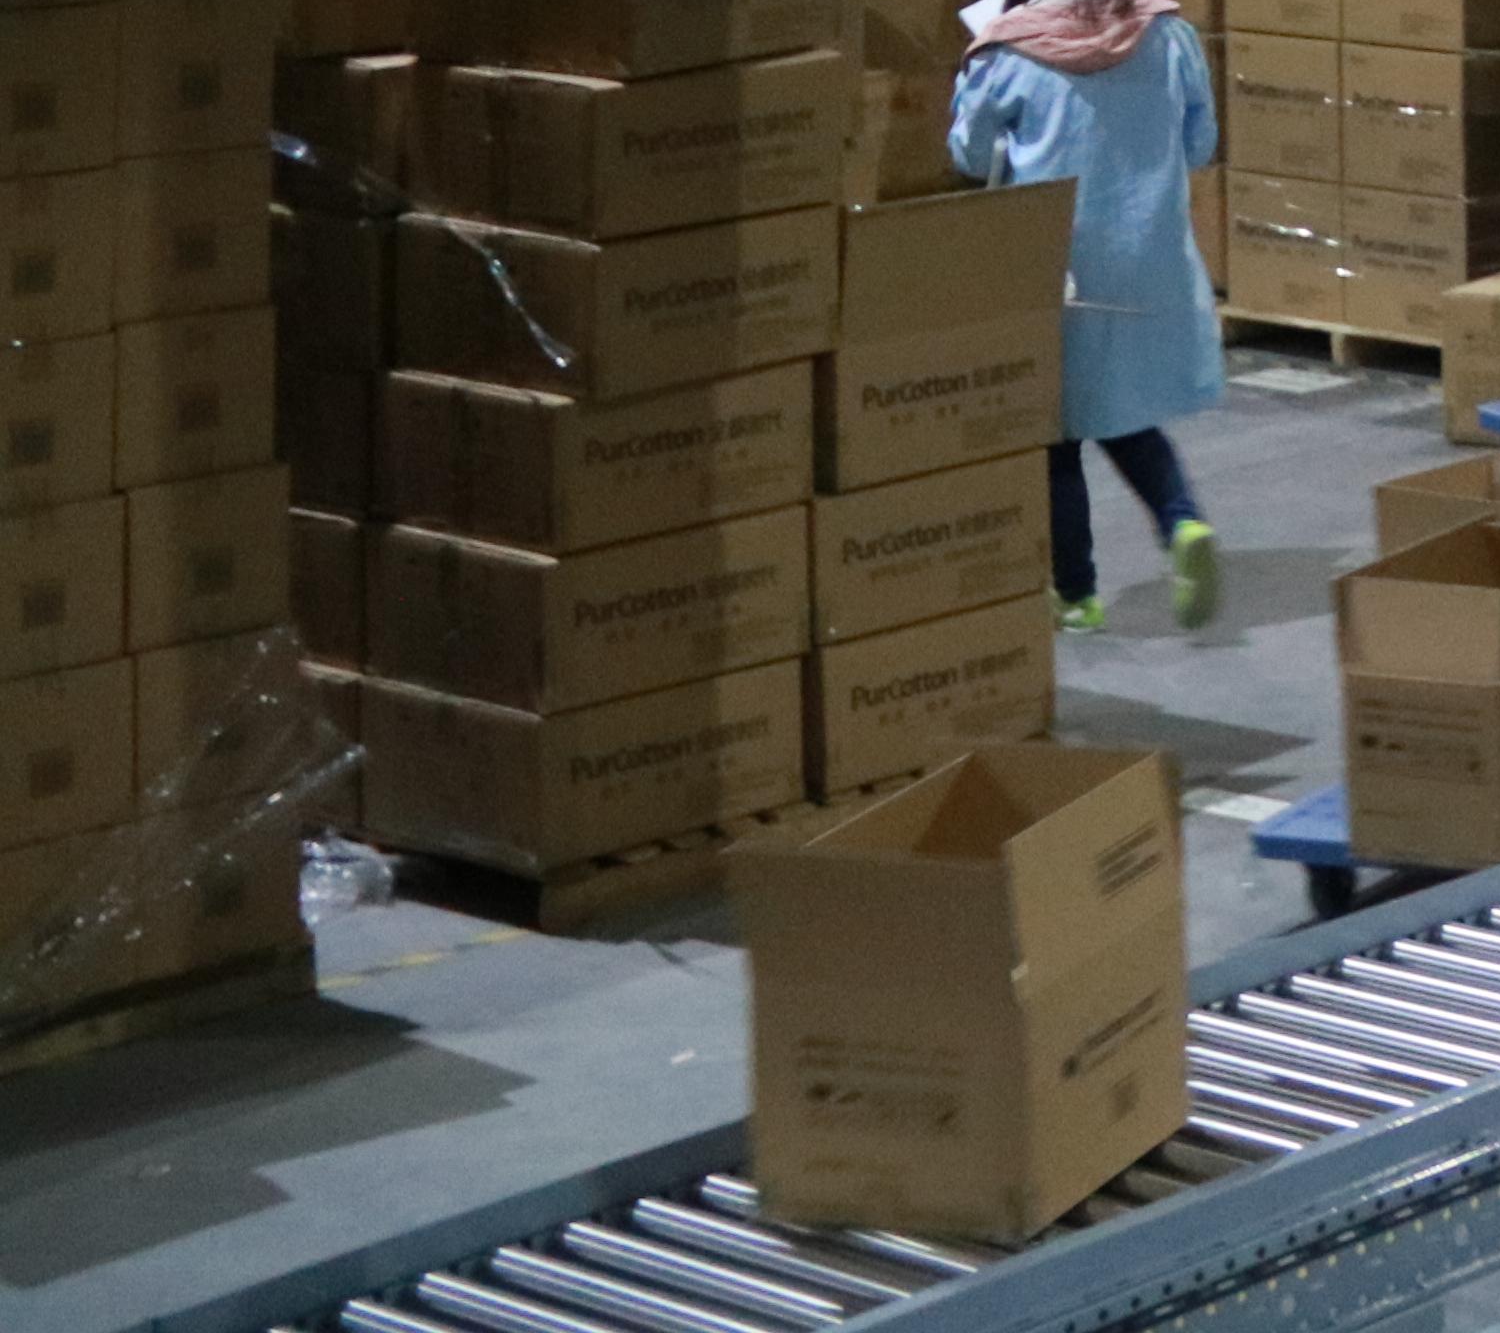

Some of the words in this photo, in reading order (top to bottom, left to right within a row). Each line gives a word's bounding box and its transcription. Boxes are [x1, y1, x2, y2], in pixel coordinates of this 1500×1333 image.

[623, 274, 738, 317] PurCotton
[861, 372, 970, 411] PurCotton
[584, 423, 704, 467] PurCotton
[841, 520, 952, 566] PurCotton
[574, 582, 699, 629] PurCotton
[851, 665, 960, 712] PurCotton
[569, 734, 694, 785] PurCotton
